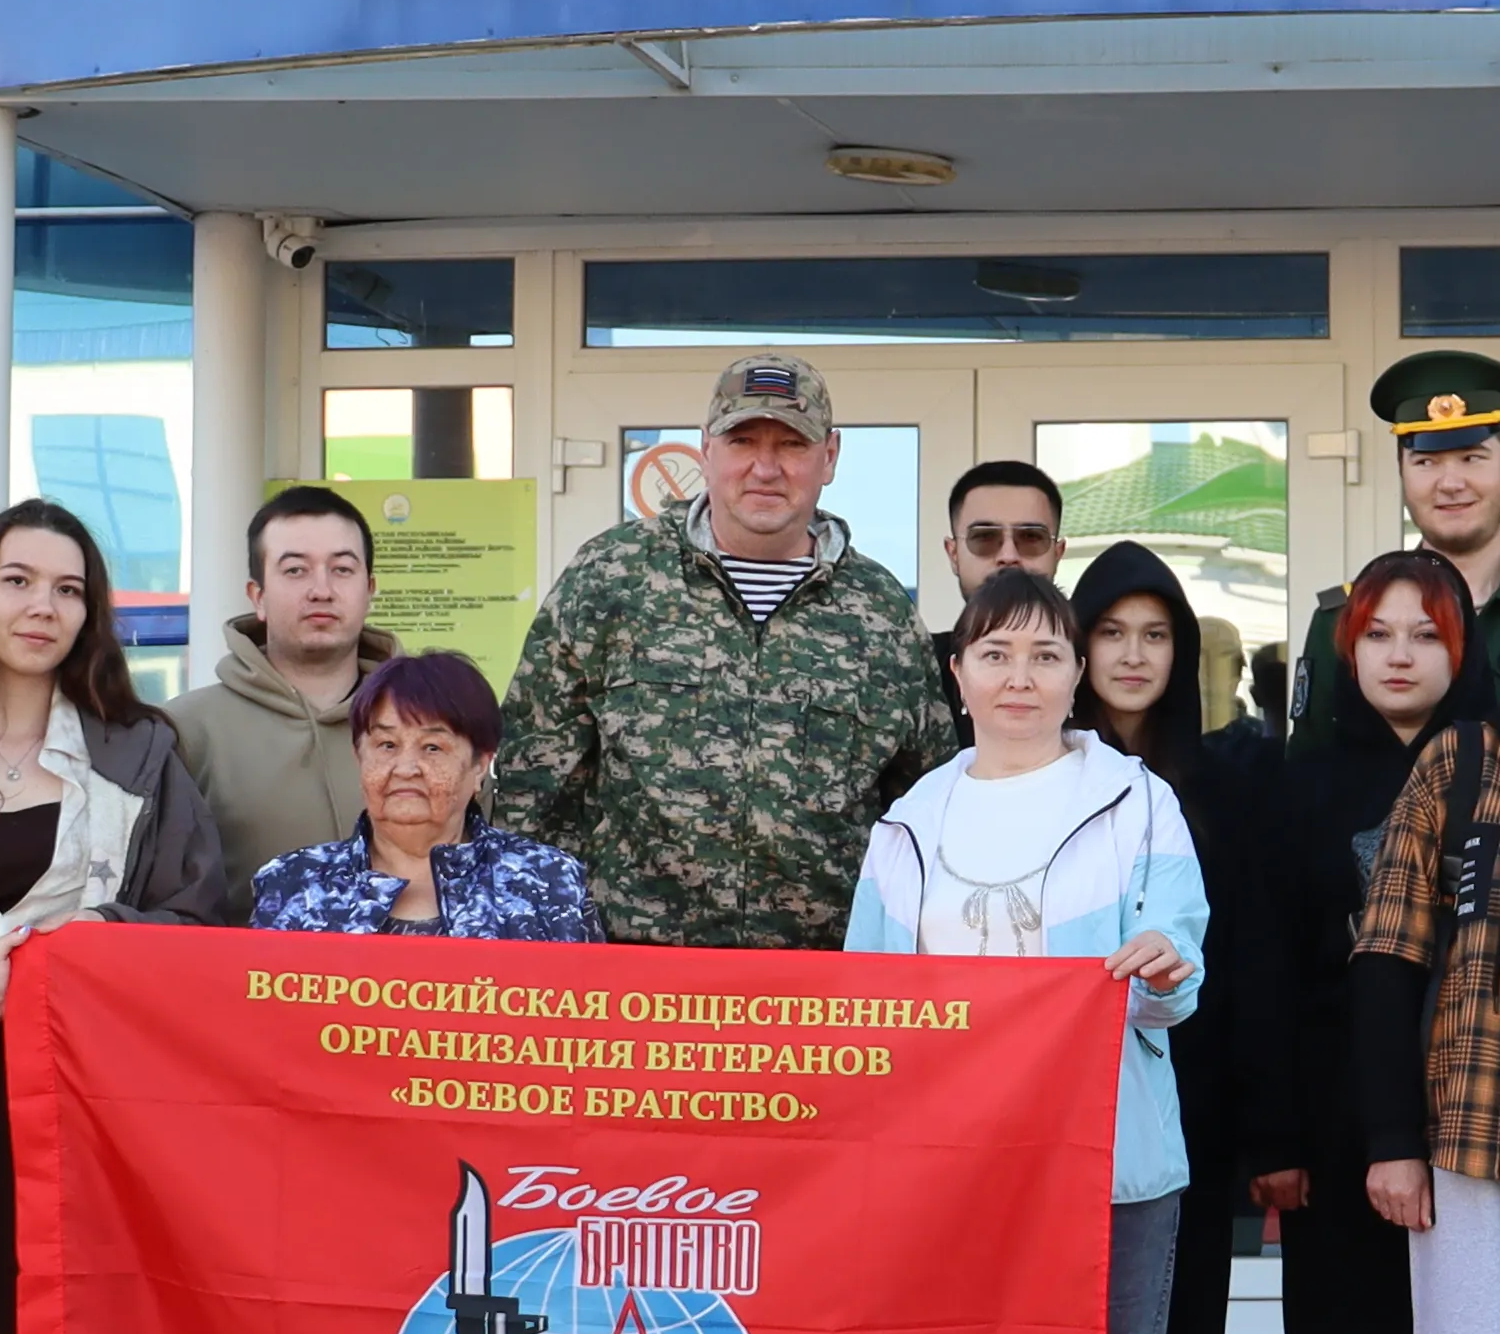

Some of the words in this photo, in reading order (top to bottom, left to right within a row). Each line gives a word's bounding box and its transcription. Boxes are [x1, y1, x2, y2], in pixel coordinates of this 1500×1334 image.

[246, 970, 610, 1020] ВСЕРОССИЙСКАЯ
[620, 992, 970, 1031] ОБЩЕСТВЕННАЯ
[319, 1023, 635, 1071] ОРГАНИЗАЦИЯ
[645, 1041, 892, 1076] ВЕТЕРАНОВ
[391, 1077, 574, 1115] «БОЕВОЕ
[584, 1087, 817, 1122] БРАТСТВО»
[497, 1166, 759, 1214] Боевое
[579, 1218, 758, 1292] БРАТСТВО
